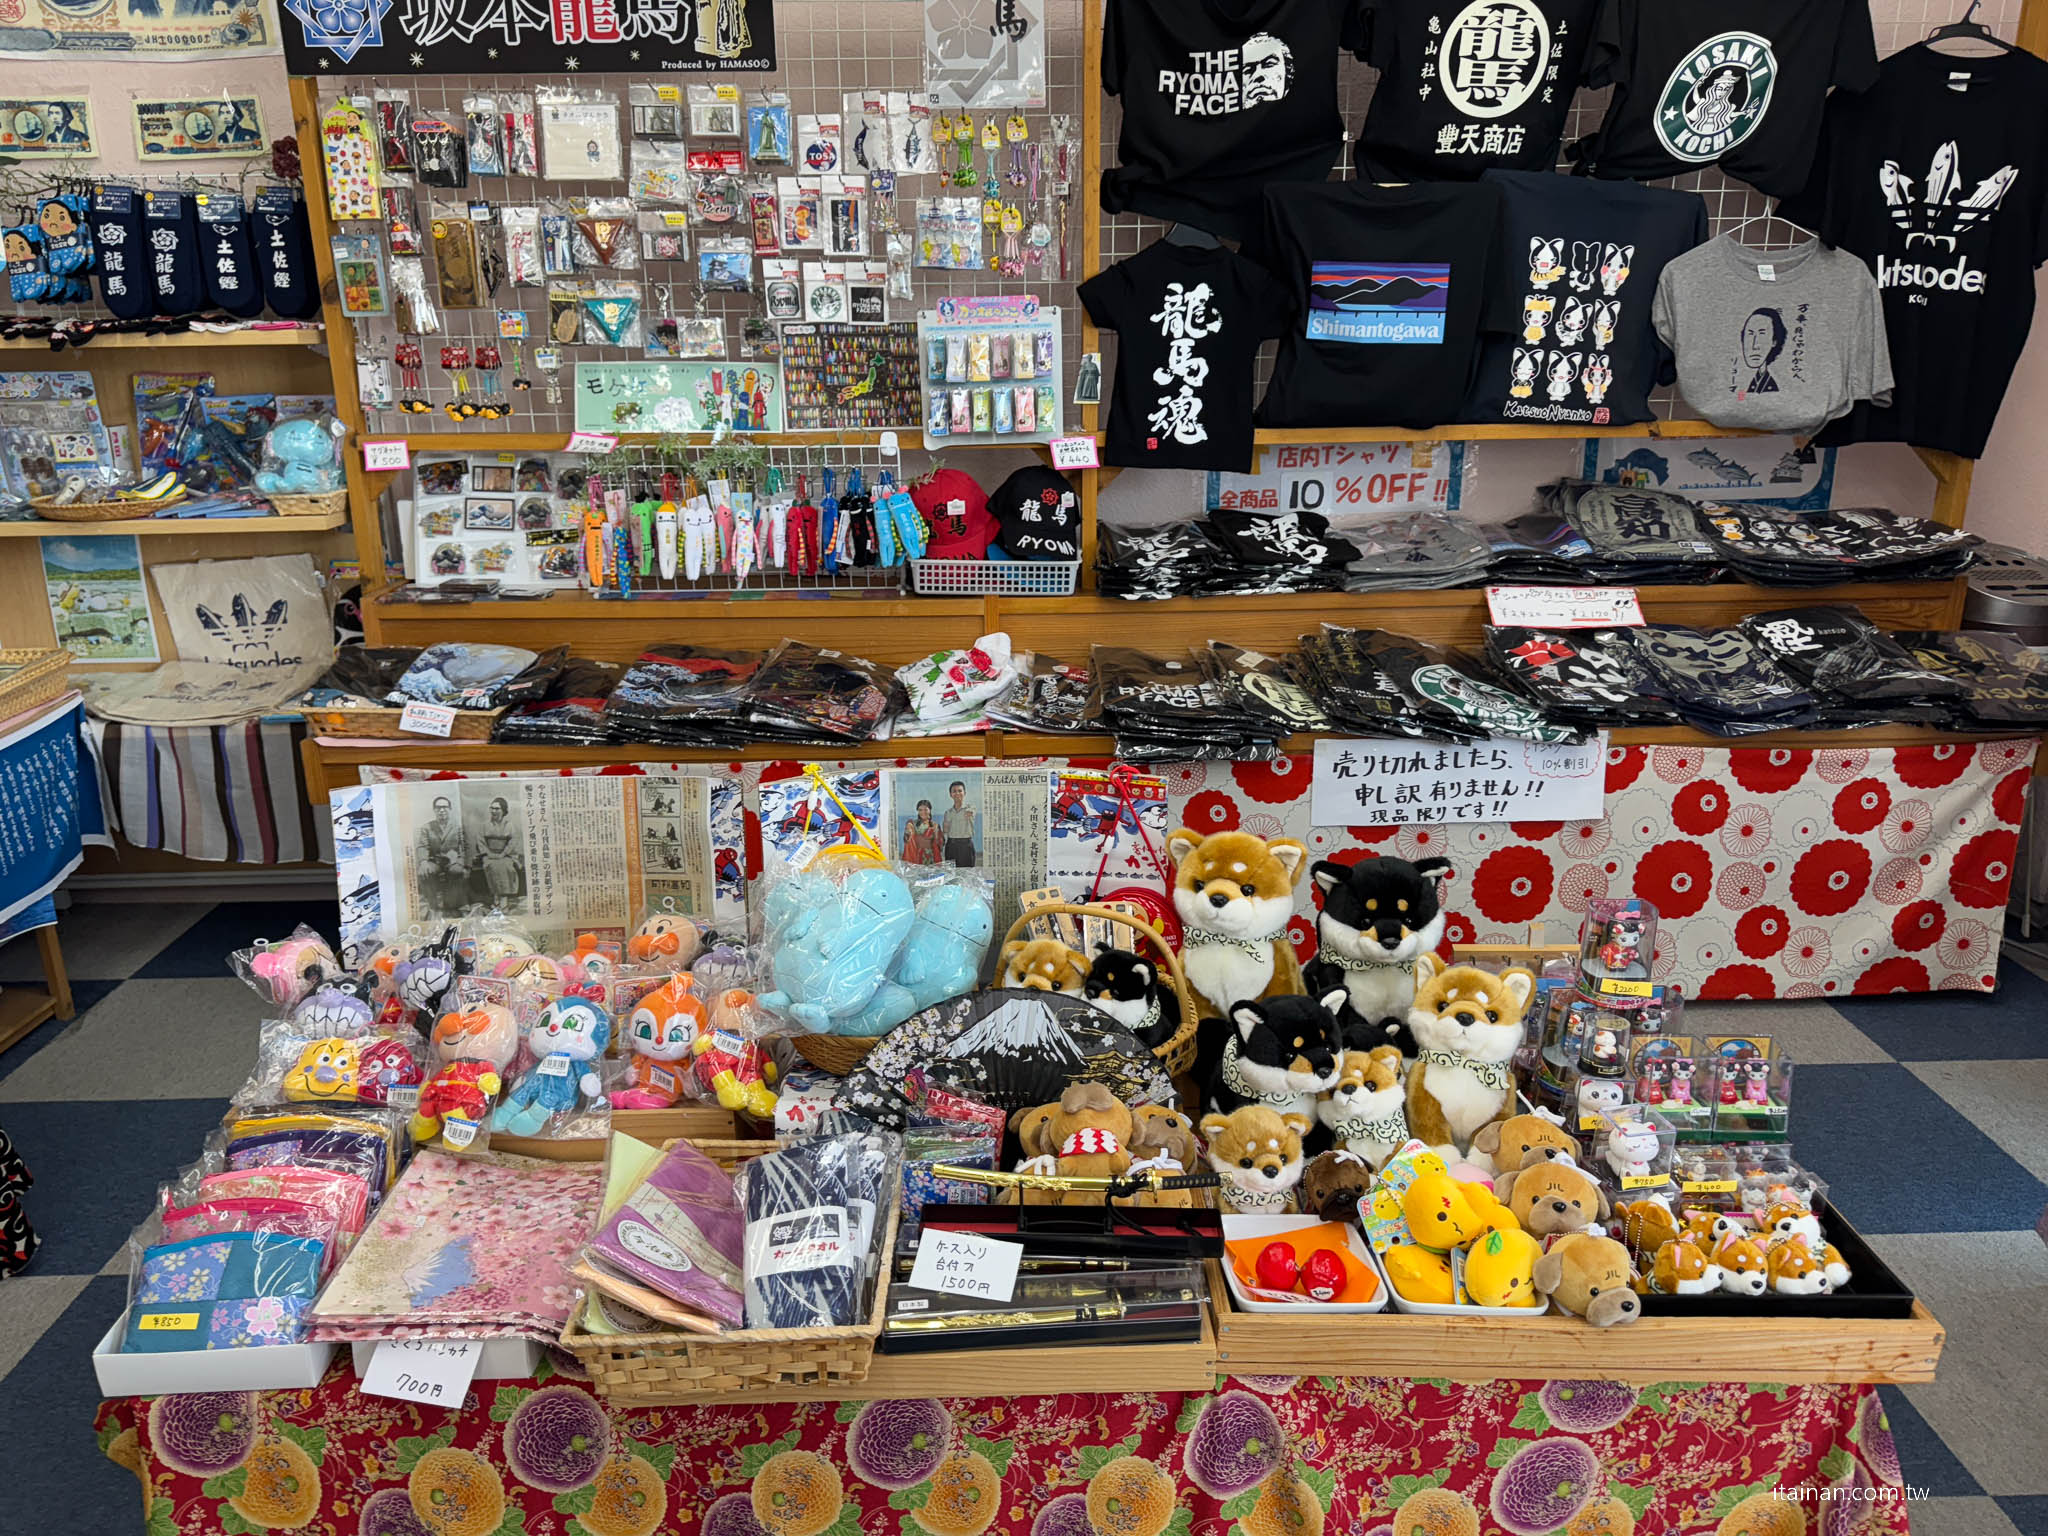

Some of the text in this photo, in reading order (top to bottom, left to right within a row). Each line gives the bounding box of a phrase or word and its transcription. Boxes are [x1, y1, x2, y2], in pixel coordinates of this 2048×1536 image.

[661, 59, 707, 70] Produced
[707, 60, 718, 71] by
[1189, 48, 1239, 72] THE
[1540, 19, 1569, 104] 土佐限定
[1158, 70, 1240, 96] RYOMA
[1174, 93, 1240, 116] FACE
[1673, 127, 1734, 154] KOCHI
[809, 152, 836, 161] TOSA
[103, 251, 127, 297] 龍馬
[155, 253, 176, 297] 龍馬
[1311, 317, 1440, 340] Shimantogawa
[1220, 489, 1279, 510] 全商品
[1288, 479, 1325, 510] 10
[1016, 535, 1076, 556] RYOMA
[1332, 749, 1514, 779] 売り切れましたら、
[936, 1239, 988, 1260] ケース入り
[941, 1275, 991, 1295] 1500円
[153, 1316, 182, 1329] ¥850
[396, 1372, 444, 1398] 700円
